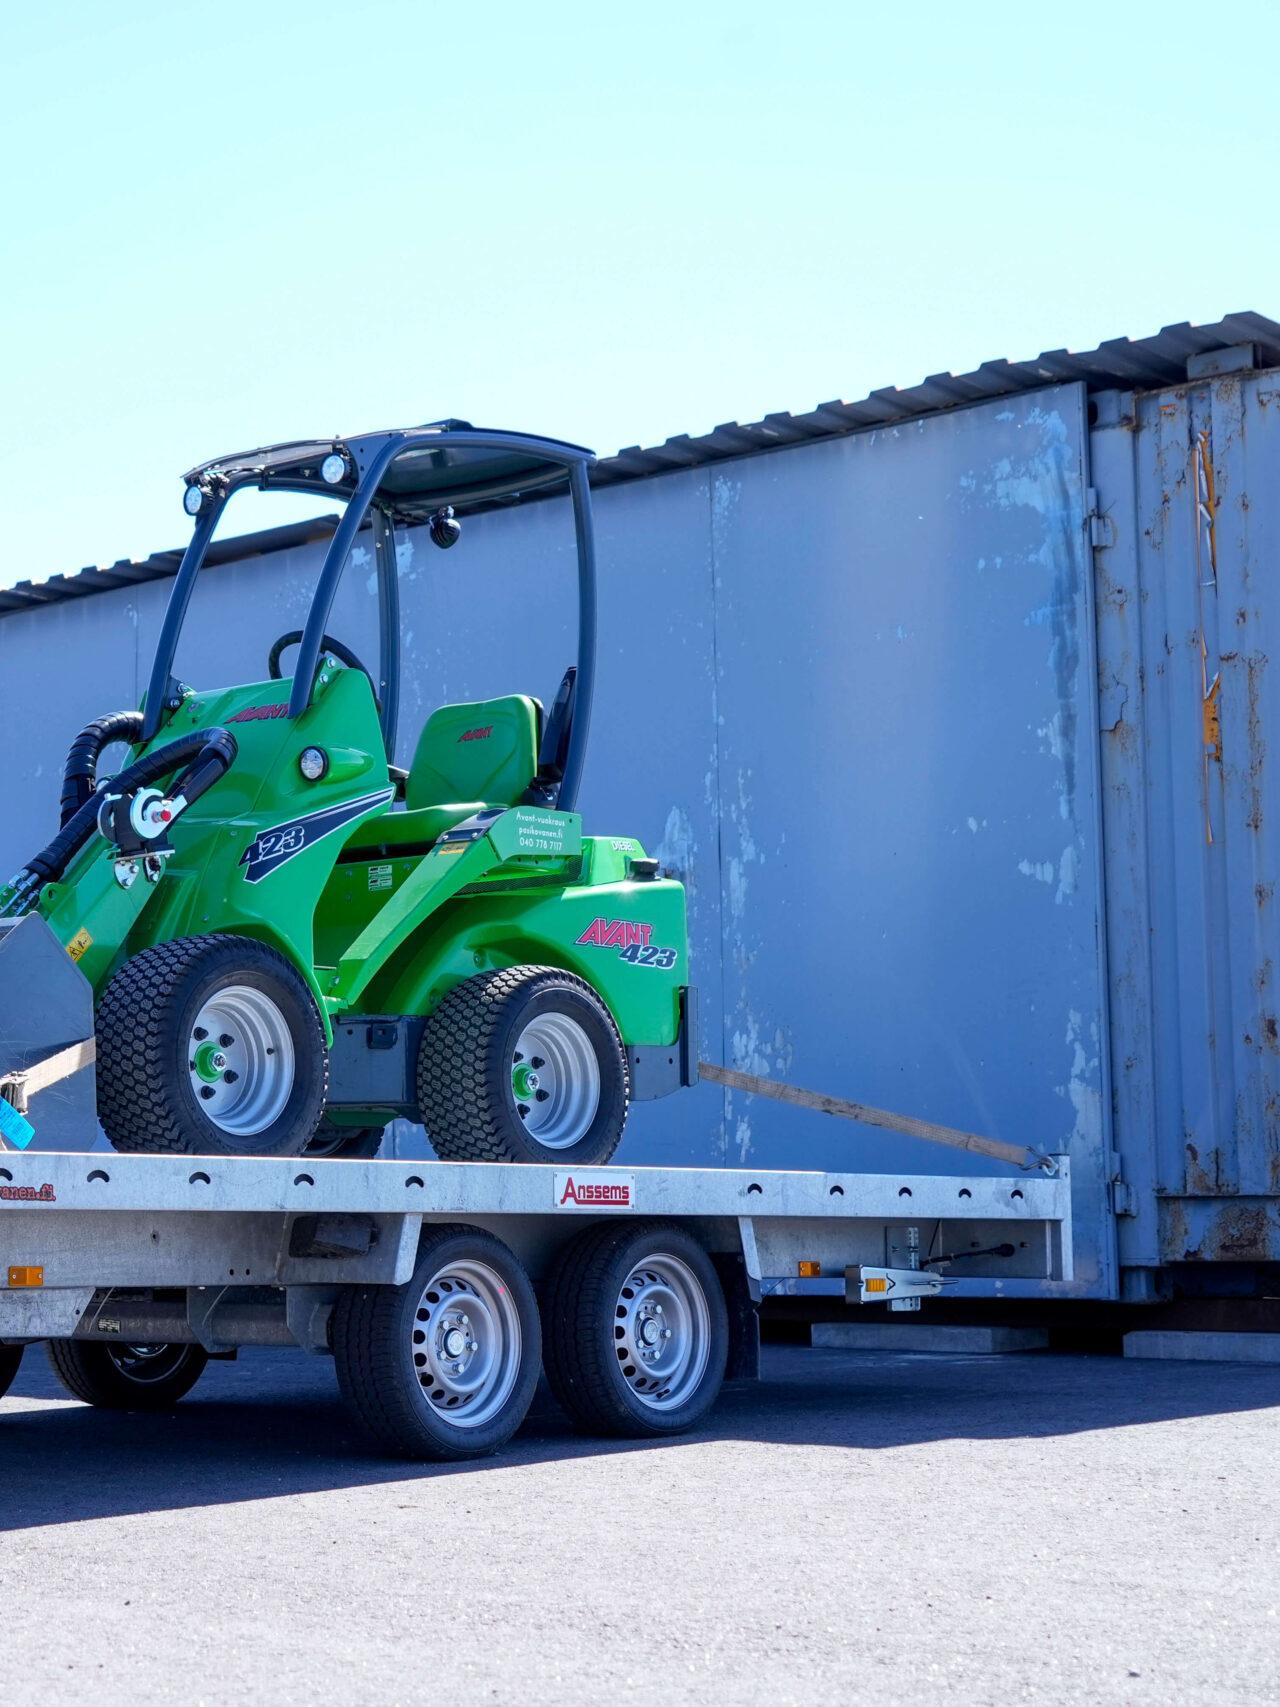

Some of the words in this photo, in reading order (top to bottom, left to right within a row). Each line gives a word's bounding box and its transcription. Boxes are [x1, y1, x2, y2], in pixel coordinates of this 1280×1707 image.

[222, 702, 290, 724] AVANT
[457, 726, 493, 743] AVANT
[516, 811, 565, 826] Avant-vuokraus
[519, 826, 563, 838] pasikovanen.fi
[238, 825, 305, 867] 423
[520, 838, 533, 846] 040
[536, 839, 548, 849] 778
[550, 841, 562, 851] 7117
[611, 840, 636, 851] DIESEL
[574, 917, 654, 949] AVANT
[619, 943, 677, 969] 423
[560, 1177, 630, 1205] Anssems
